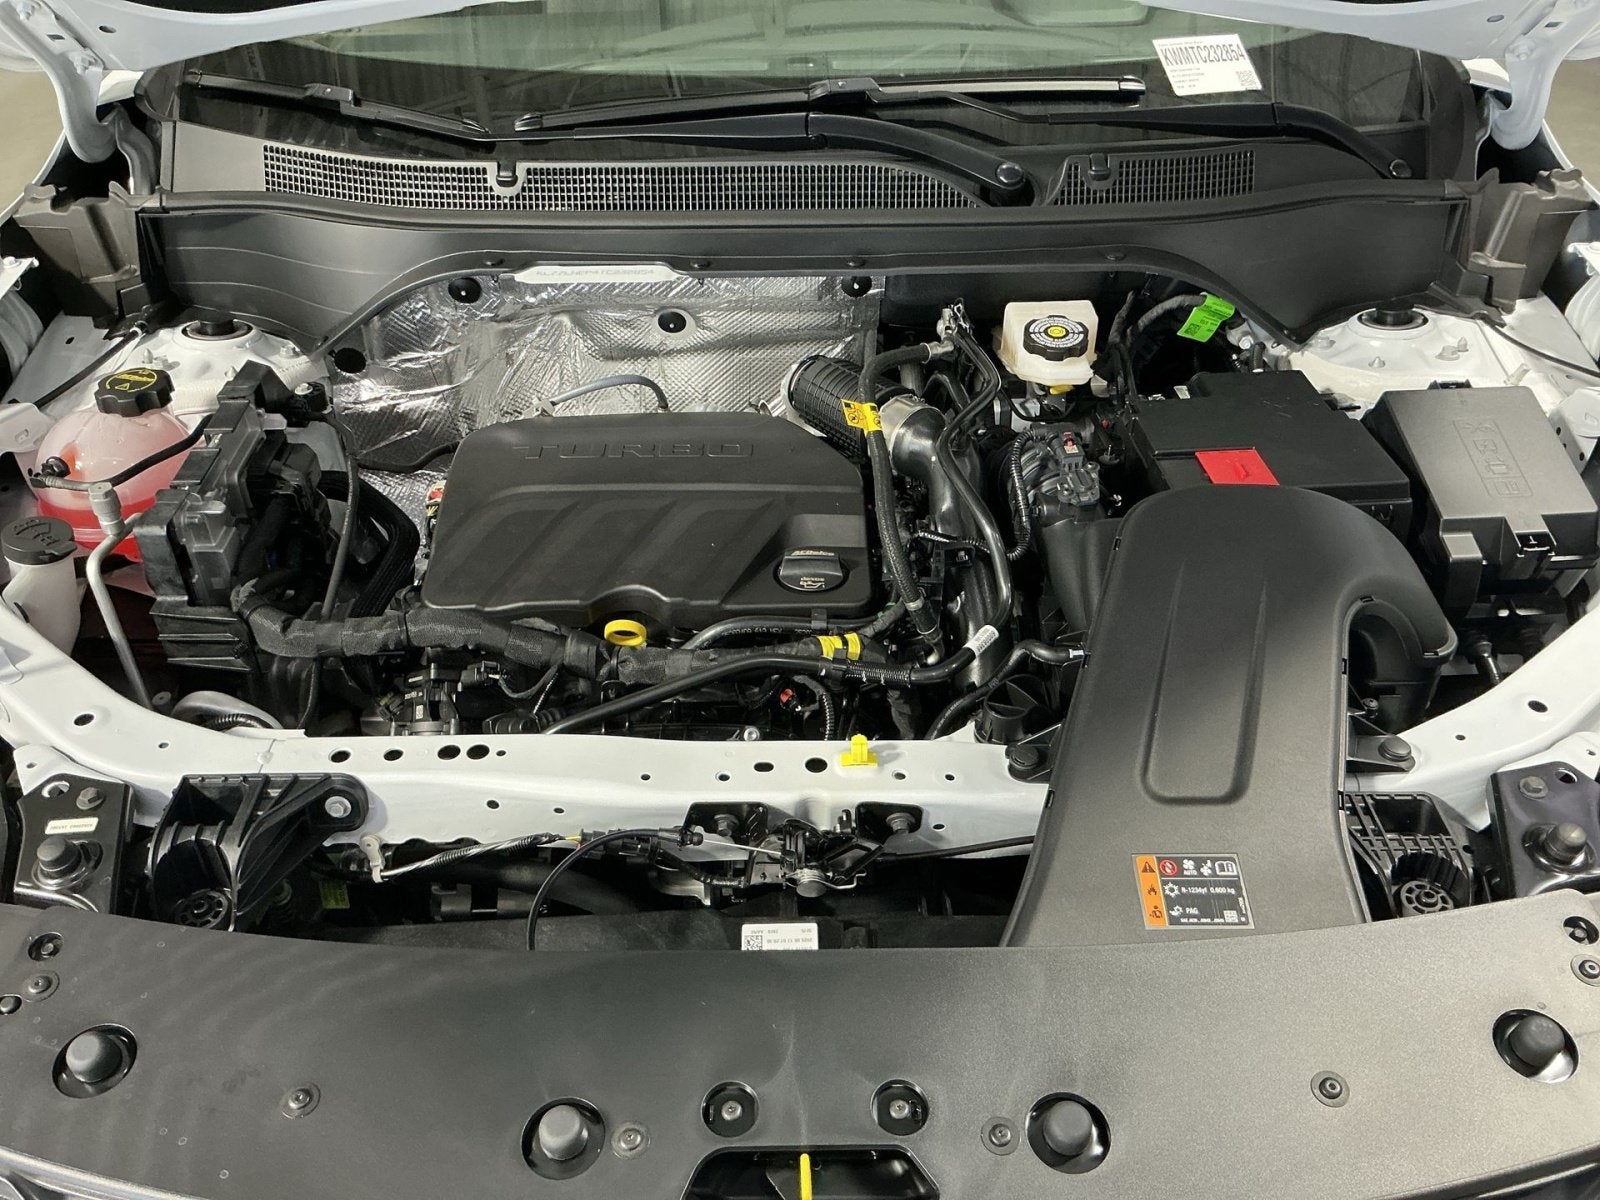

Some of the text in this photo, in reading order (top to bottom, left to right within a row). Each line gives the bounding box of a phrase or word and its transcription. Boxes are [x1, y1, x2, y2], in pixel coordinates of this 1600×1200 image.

[1160, 44, 1246, 66] KWMTC232854
[513, 443, 754, 459] TURBO
[1181, 886, 1208, 895] R-1234yf
[1185, 907, 1199, 915] PAG
